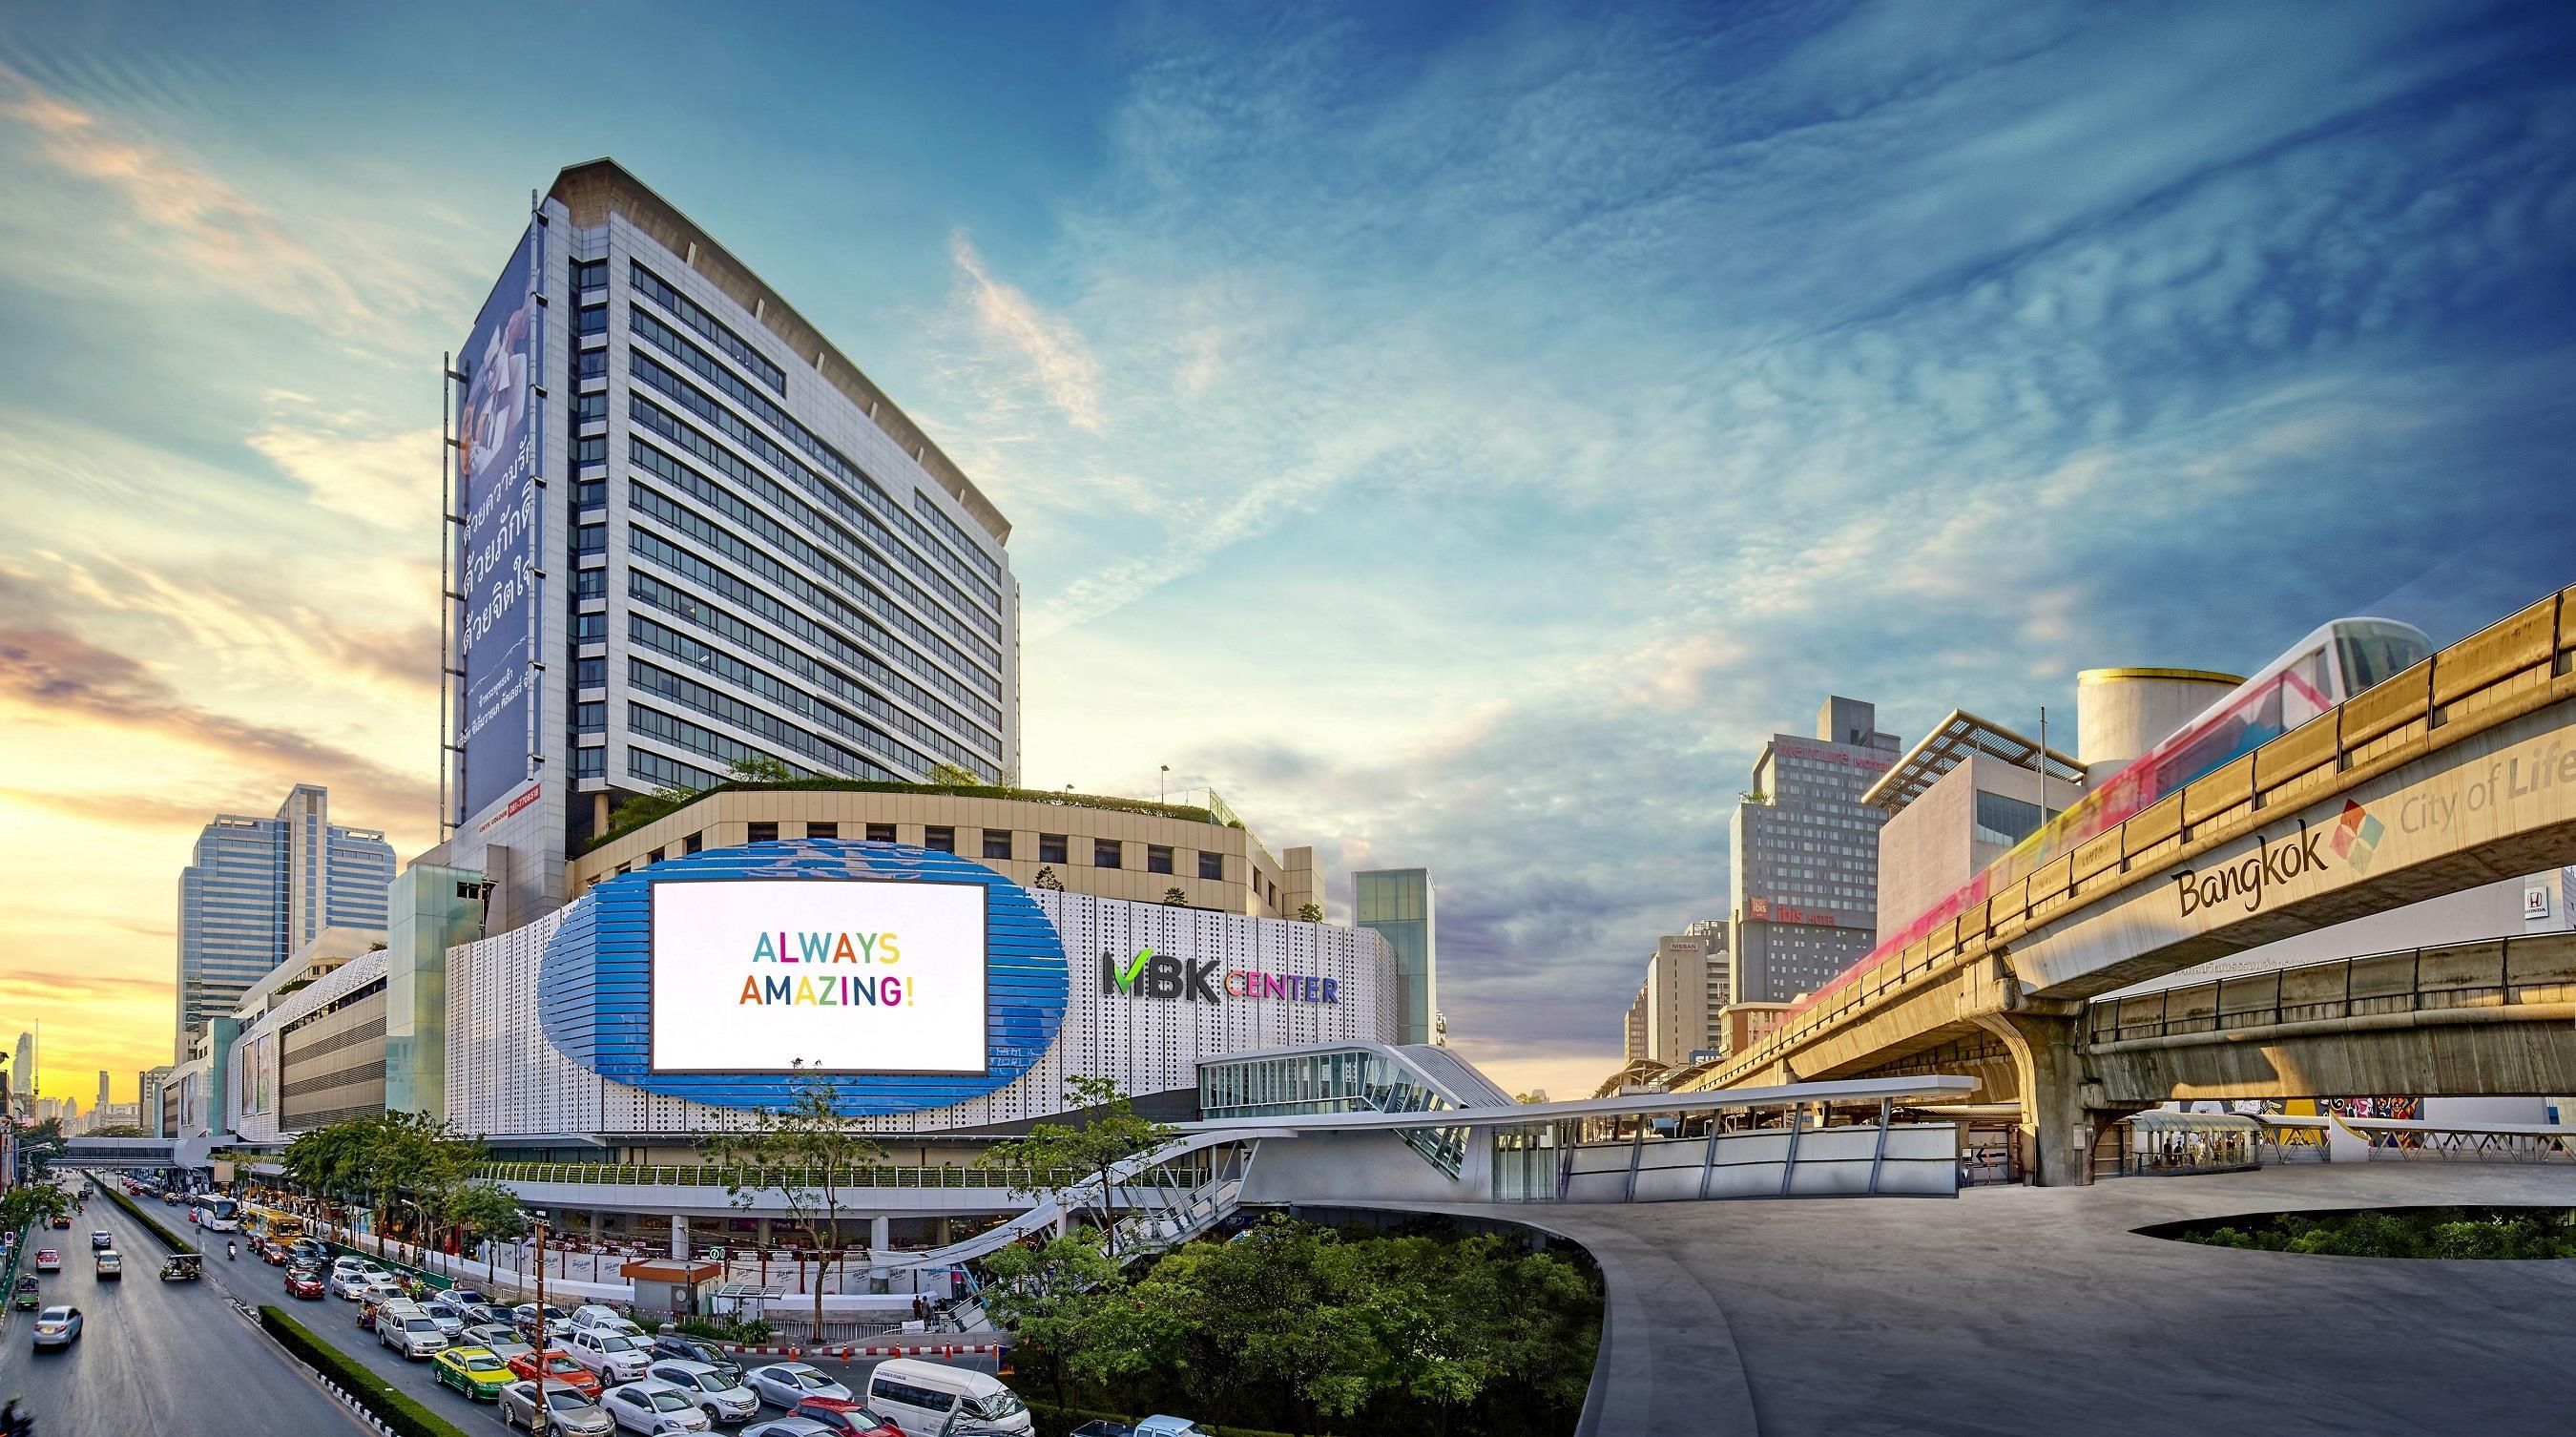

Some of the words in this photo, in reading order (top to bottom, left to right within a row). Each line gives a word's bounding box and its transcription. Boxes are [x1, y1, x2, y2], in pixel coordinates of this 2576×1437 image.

[2171, 818, 2328, 918] Bangkok
[2399, 790, 2459, 835] City
[2467, 761, 2503, 813] of
[2507, 739, 2576, 800] Life
[1753, 902, 1767, 913] ibis
[1777, 905, 1802, 924] ibis
[752, 931, 901, 965] ALWAYS
[739, 975, 914, 1007] AMAZING!
[1103, 948, 1221, 1004] MBK
[1224, 968, 1339, 1003] CENTER
